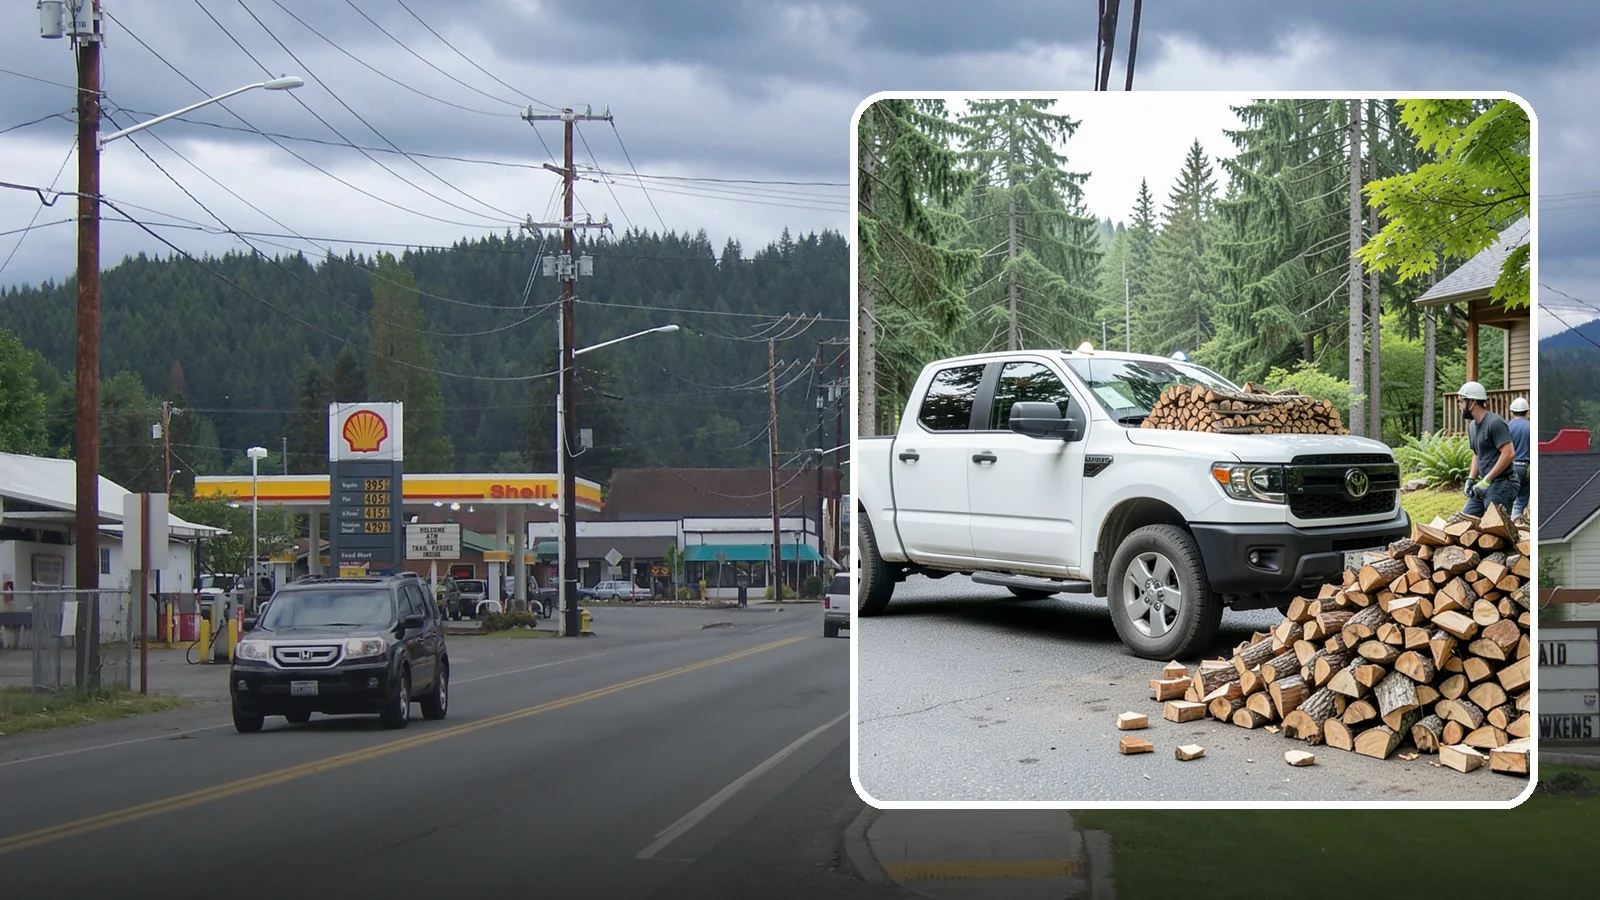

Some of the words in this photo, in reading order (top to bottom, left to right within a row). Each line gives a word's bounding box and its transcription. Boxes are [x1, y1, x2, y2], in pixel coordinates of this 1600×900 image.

[365, 480, 384, 490] 395
[490, 484, 547, 499] Shell
[365, 494, 384, 504] 405
[365, 508, 384, 518] 415
[366, 522, 384, 533] 429
